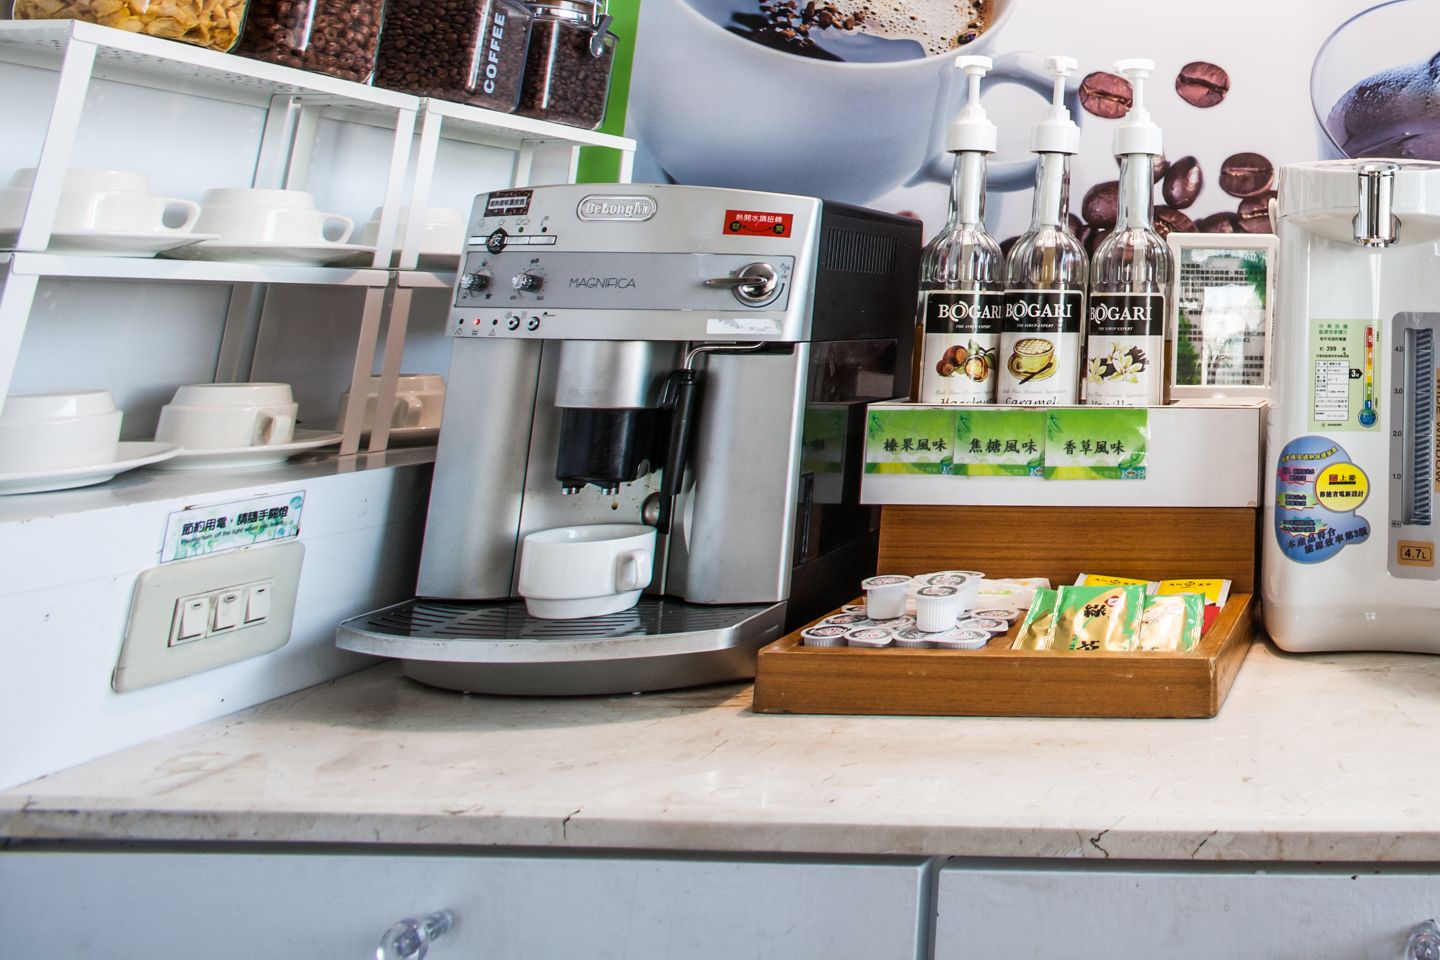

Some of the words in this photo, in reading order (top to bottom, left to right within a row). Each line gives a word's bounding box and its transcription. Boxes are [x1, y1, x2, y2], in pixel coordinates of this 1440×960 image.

[483, 12, 506, 95] COFFEE
[568, 277, 636, 289] MAGNIFICA
[1005, 299, 1072, 321] BOGARI
[1089, 302, 1153, 325] BOGARI
[968, 438, 1038, 454] 焦糖風味
[1063, 440, 1126, 456] 香草風味
[1404, 548, 1427, 560] 4.7L
